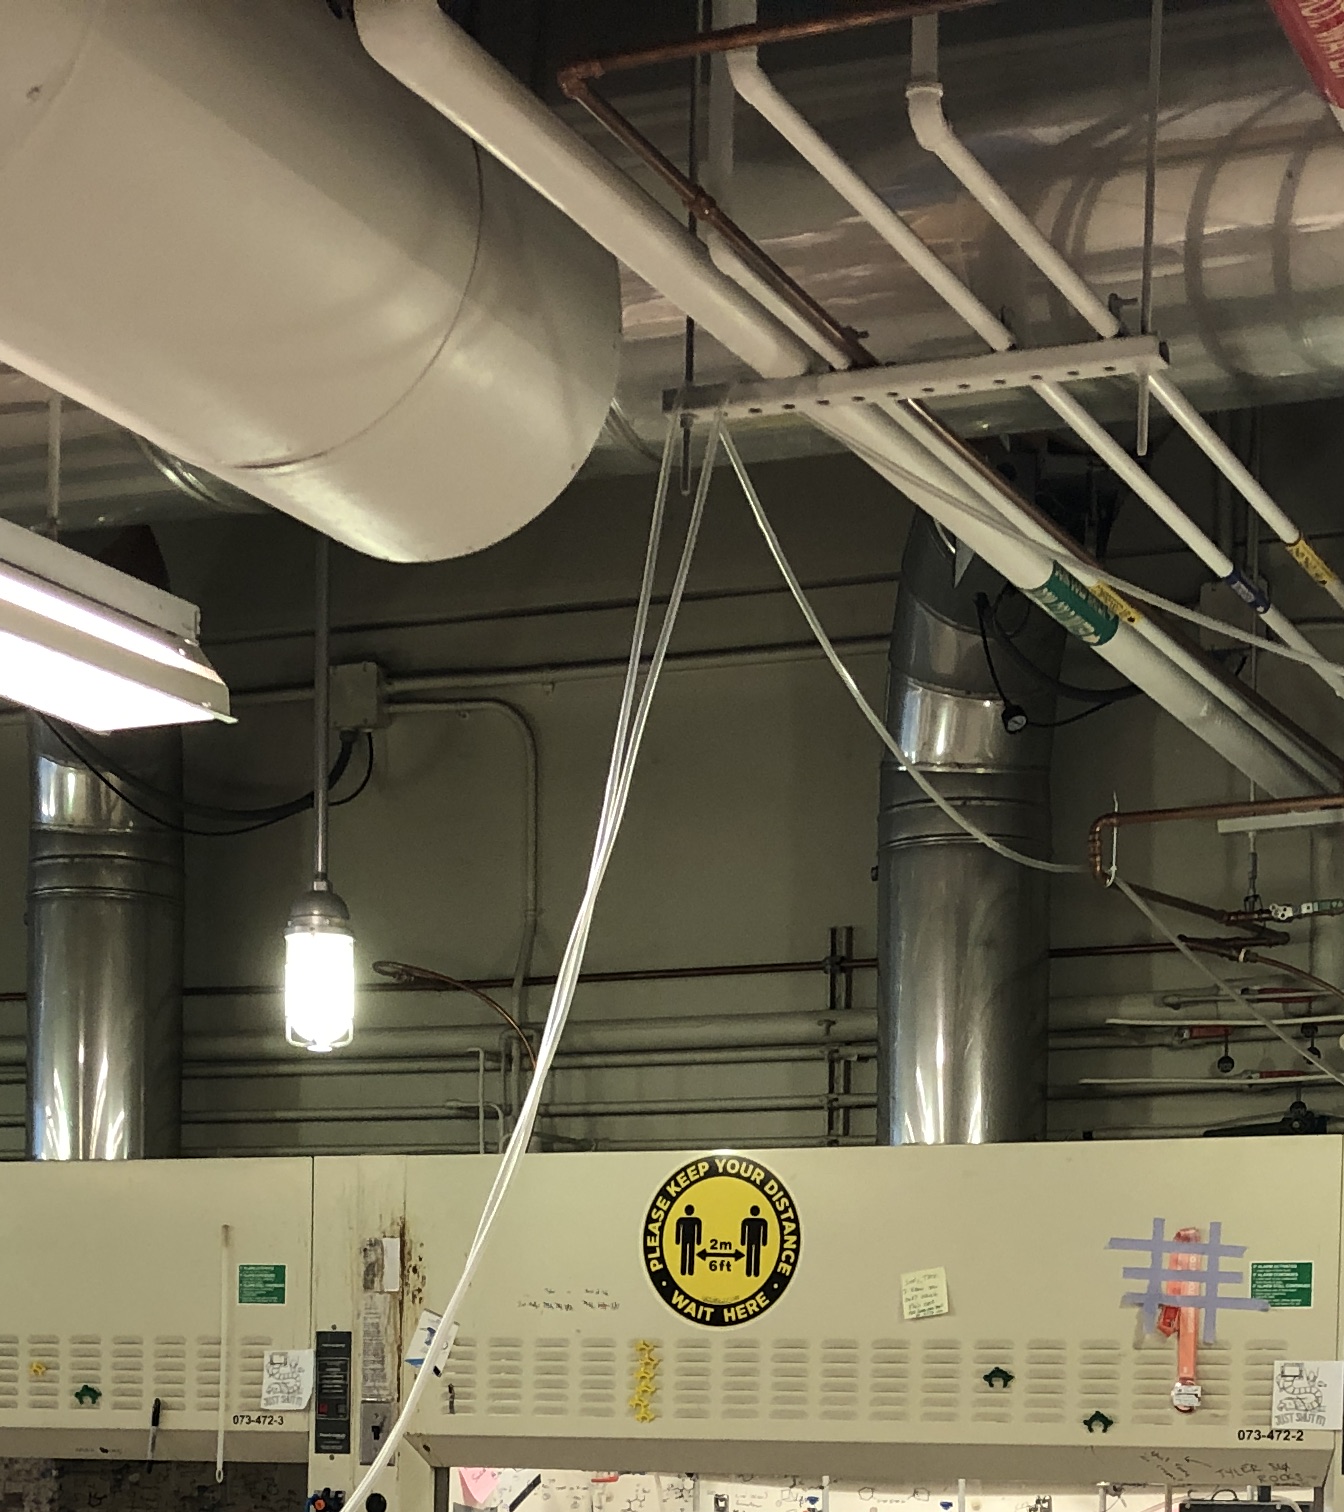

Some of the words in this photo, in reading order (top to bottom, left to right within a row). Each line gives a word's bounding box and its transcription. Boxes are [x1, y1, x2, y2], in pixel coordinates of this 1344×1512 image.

[646, 1196, 671, 1272] PLEASE
[666, 1161, 709, 1197] KEEP
[714, 1158, 765, 1186] YOUR
[763, 1179, 797, 1277] DISTANCE
[709, 1238, 733, 1251] 2m
[708, 1260, 732, 1272] 6ft
[670, 1289, 715, 1322] WAIT
[723, 1291, 770, 1322] HERE
[233, 1415, 284, 1425] 073-472-3
[1275, 1413, 1295, 1425] JUST
[1296, 1413, 1315, 1423] SHUT
[1237, 1429, 1304, 1441] 073-472-2
[1215, 1463, 1263, 1479] TYLER
